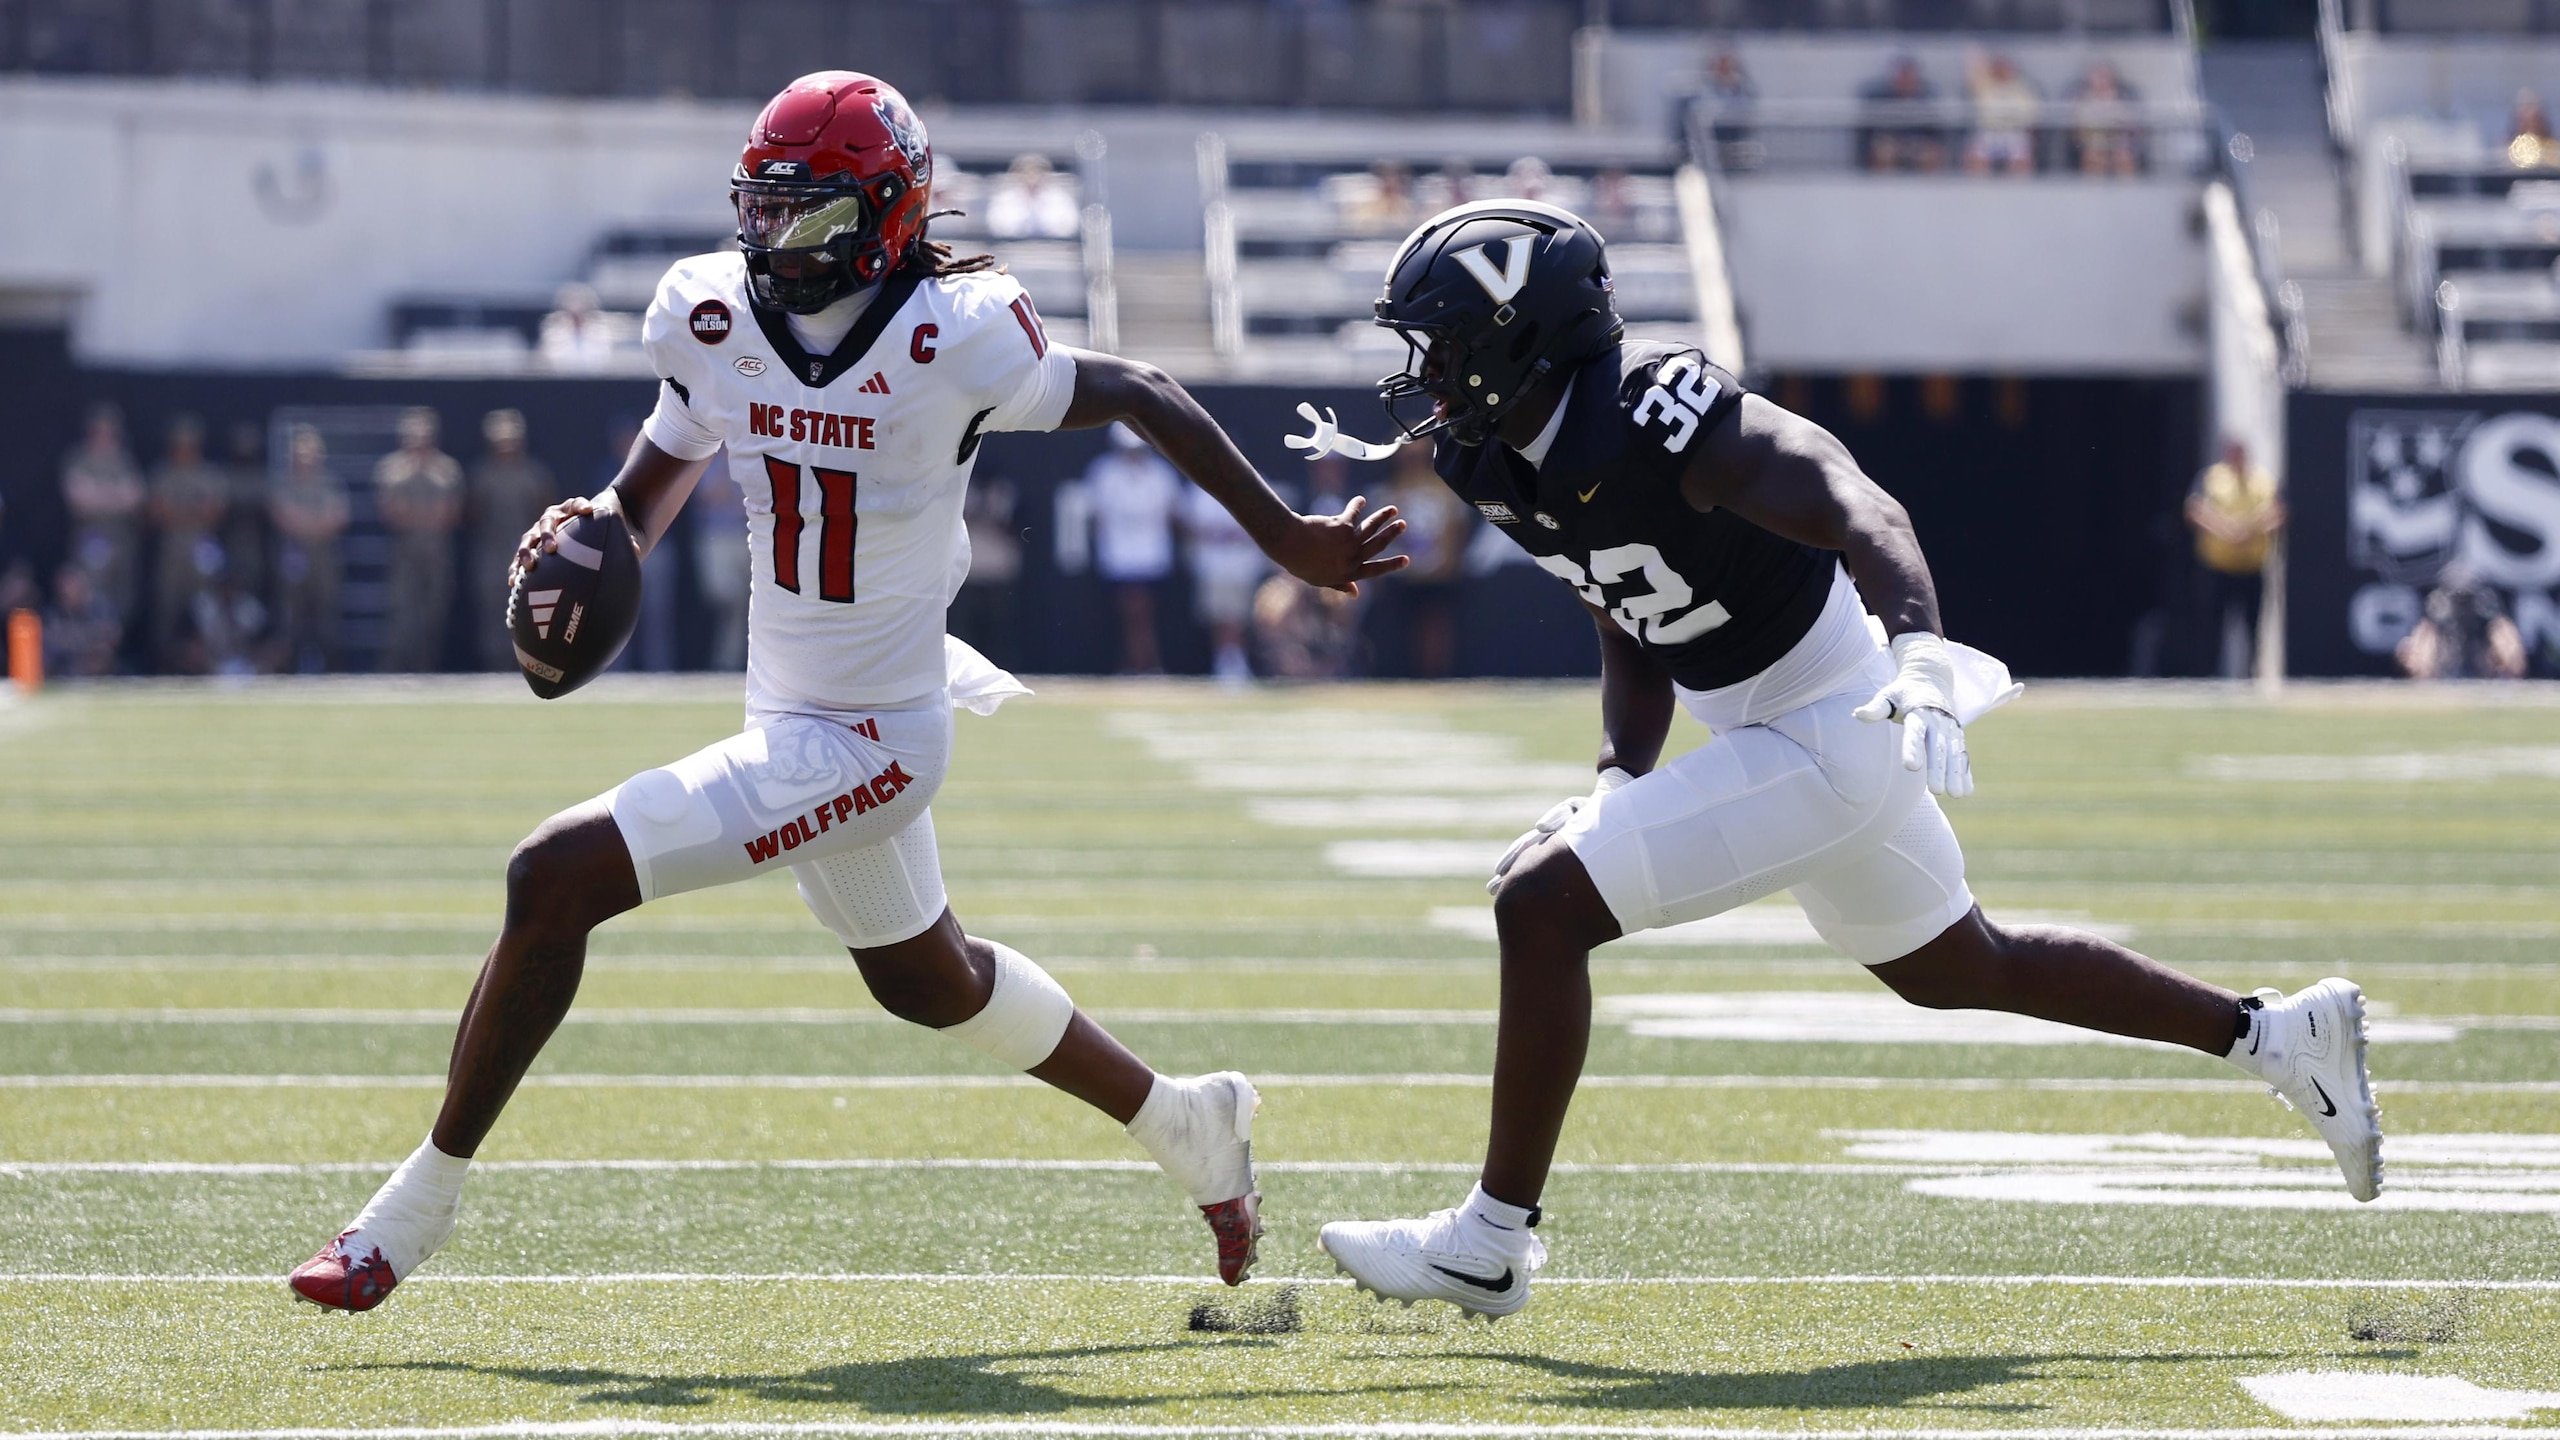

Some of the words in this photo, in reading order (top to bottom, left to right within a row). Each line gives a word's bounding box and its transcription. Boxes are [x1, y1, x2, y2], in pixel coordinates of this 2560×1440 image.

[764, 162, 799, 175] ACC
[1450, 234, 1538, 305] V
[693, 320, 728, 331] WILSON
[910, 323, 939, 364] C
[738, 360, 762, 370] ACC
[749, 402, 784, 438] NC
[790, 408, 876, 450] STATE
[1633, 357, 1722, 454] 32
[763, 453, 858, 604] 11
[563, 601, 584, 645] DIME
[744, 759, 914, 865] WOLFPACK
